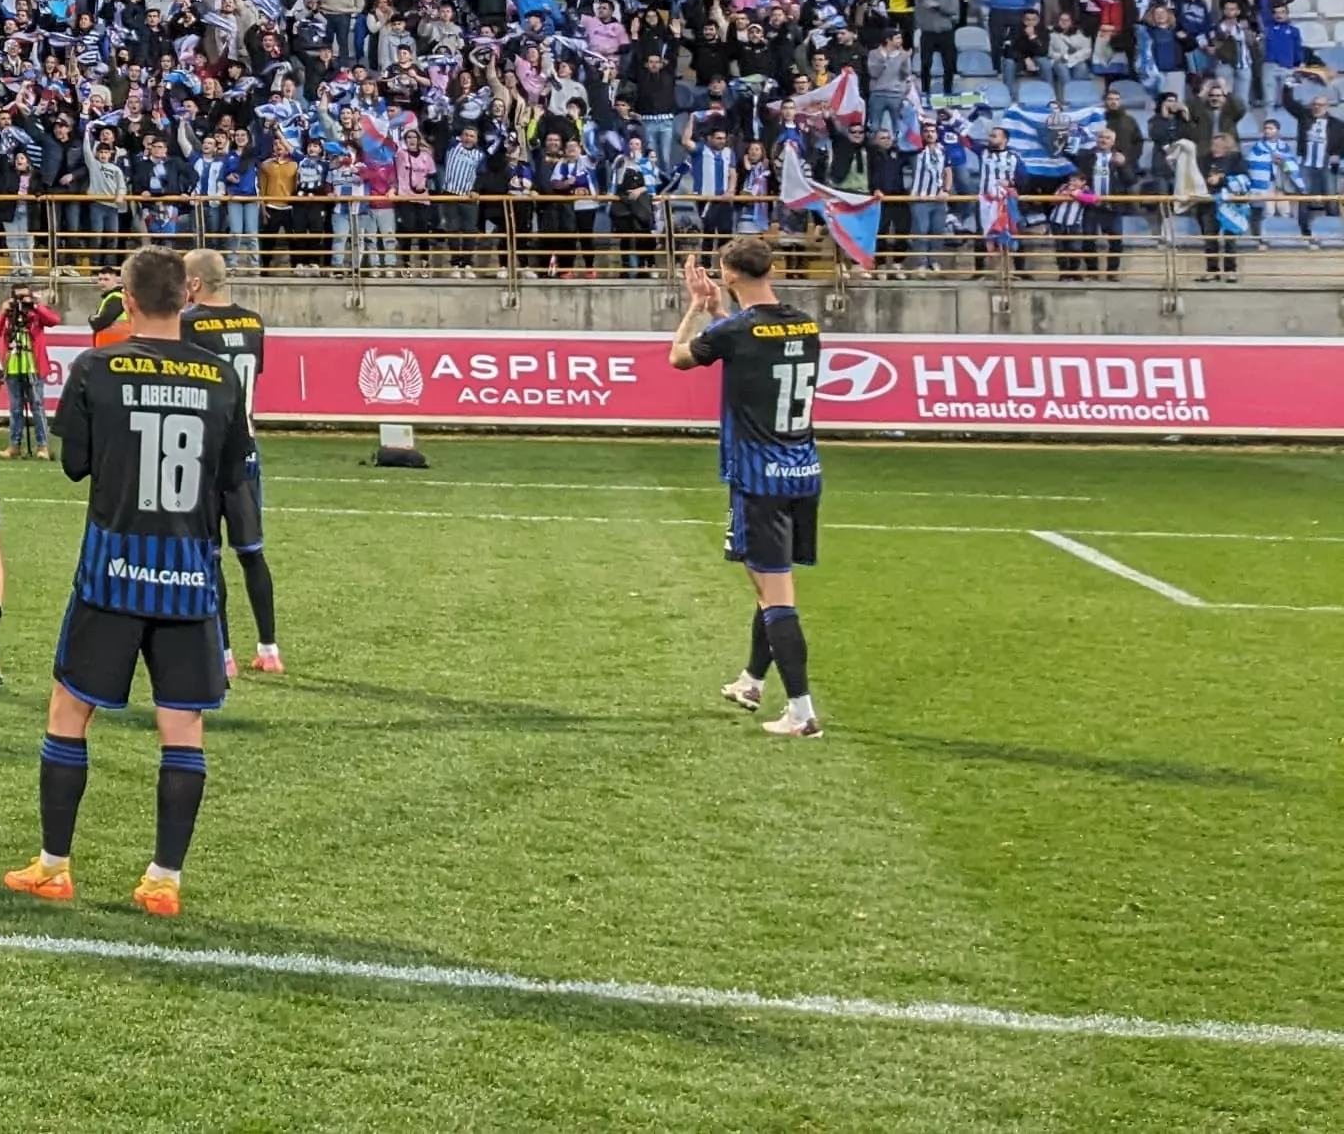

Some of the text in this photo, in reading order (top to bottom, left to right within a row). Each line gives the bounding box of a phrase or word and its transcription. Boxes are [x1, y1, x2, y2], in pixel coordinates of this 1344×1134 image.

[194, 319, 224, 331] CAJA
[752, 325, 785, 337] CAJA
[109, 357, 157, 375] CAJA
[431, 351, 638, 386] ASPIRE
[913, 355, 1206, 400] HYUNDAI
[123, 385, 208, 411] B. ABELENDA
[457, 387, 612, 406] ACADEMY
[773, 362, 816, 433] 15
[918, 398, 1209, 422] Lemauto Automoción
[130, 411, 204, 513] 18
[129, 565, 205, 587] VALCARCE
